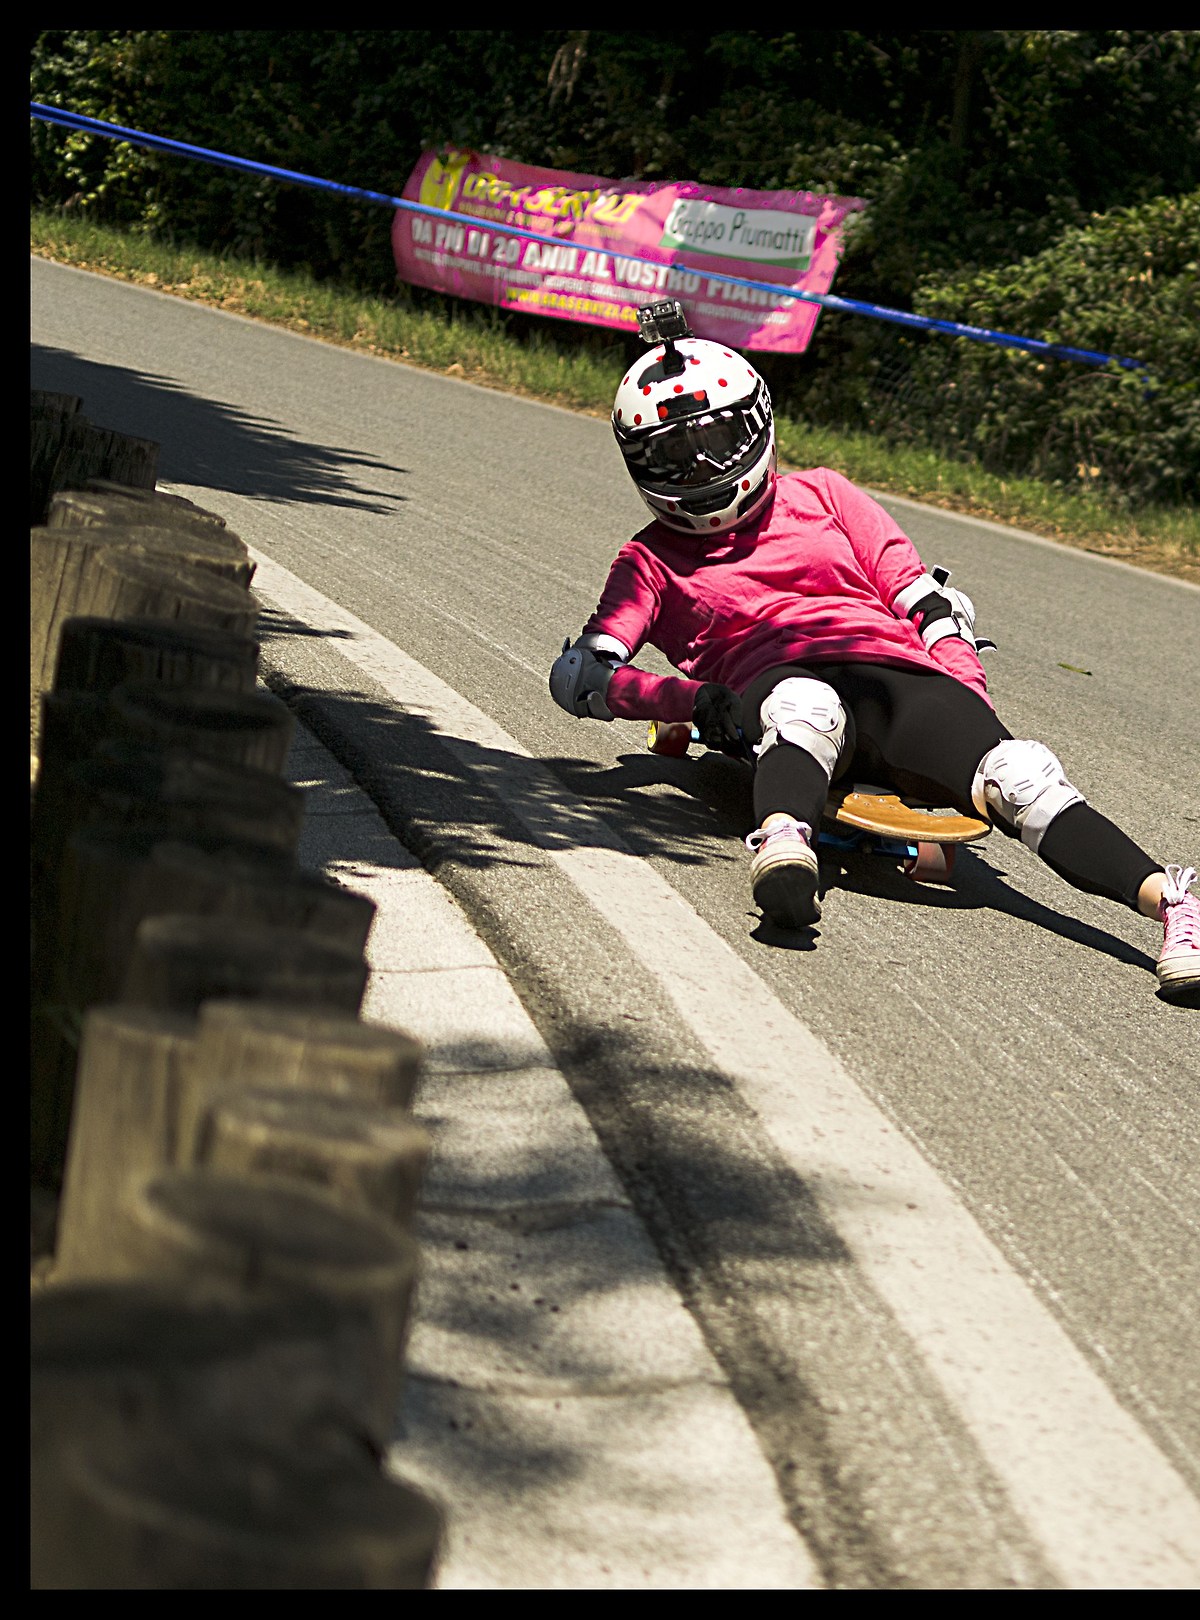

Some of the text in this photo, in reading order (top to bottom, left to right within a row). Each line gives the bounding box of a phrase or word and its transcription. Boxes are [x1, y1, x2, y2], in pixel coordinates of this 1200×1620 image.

[729, 212, 805, 253] Piumatti
[467, 229, 490, 258] DI
[492, 236, 521, 263] 20
[522, 241, 578, 273] ANNI
[581, 250, 611, 279] AL
[614, 256, 700, 295] VOSTRO
